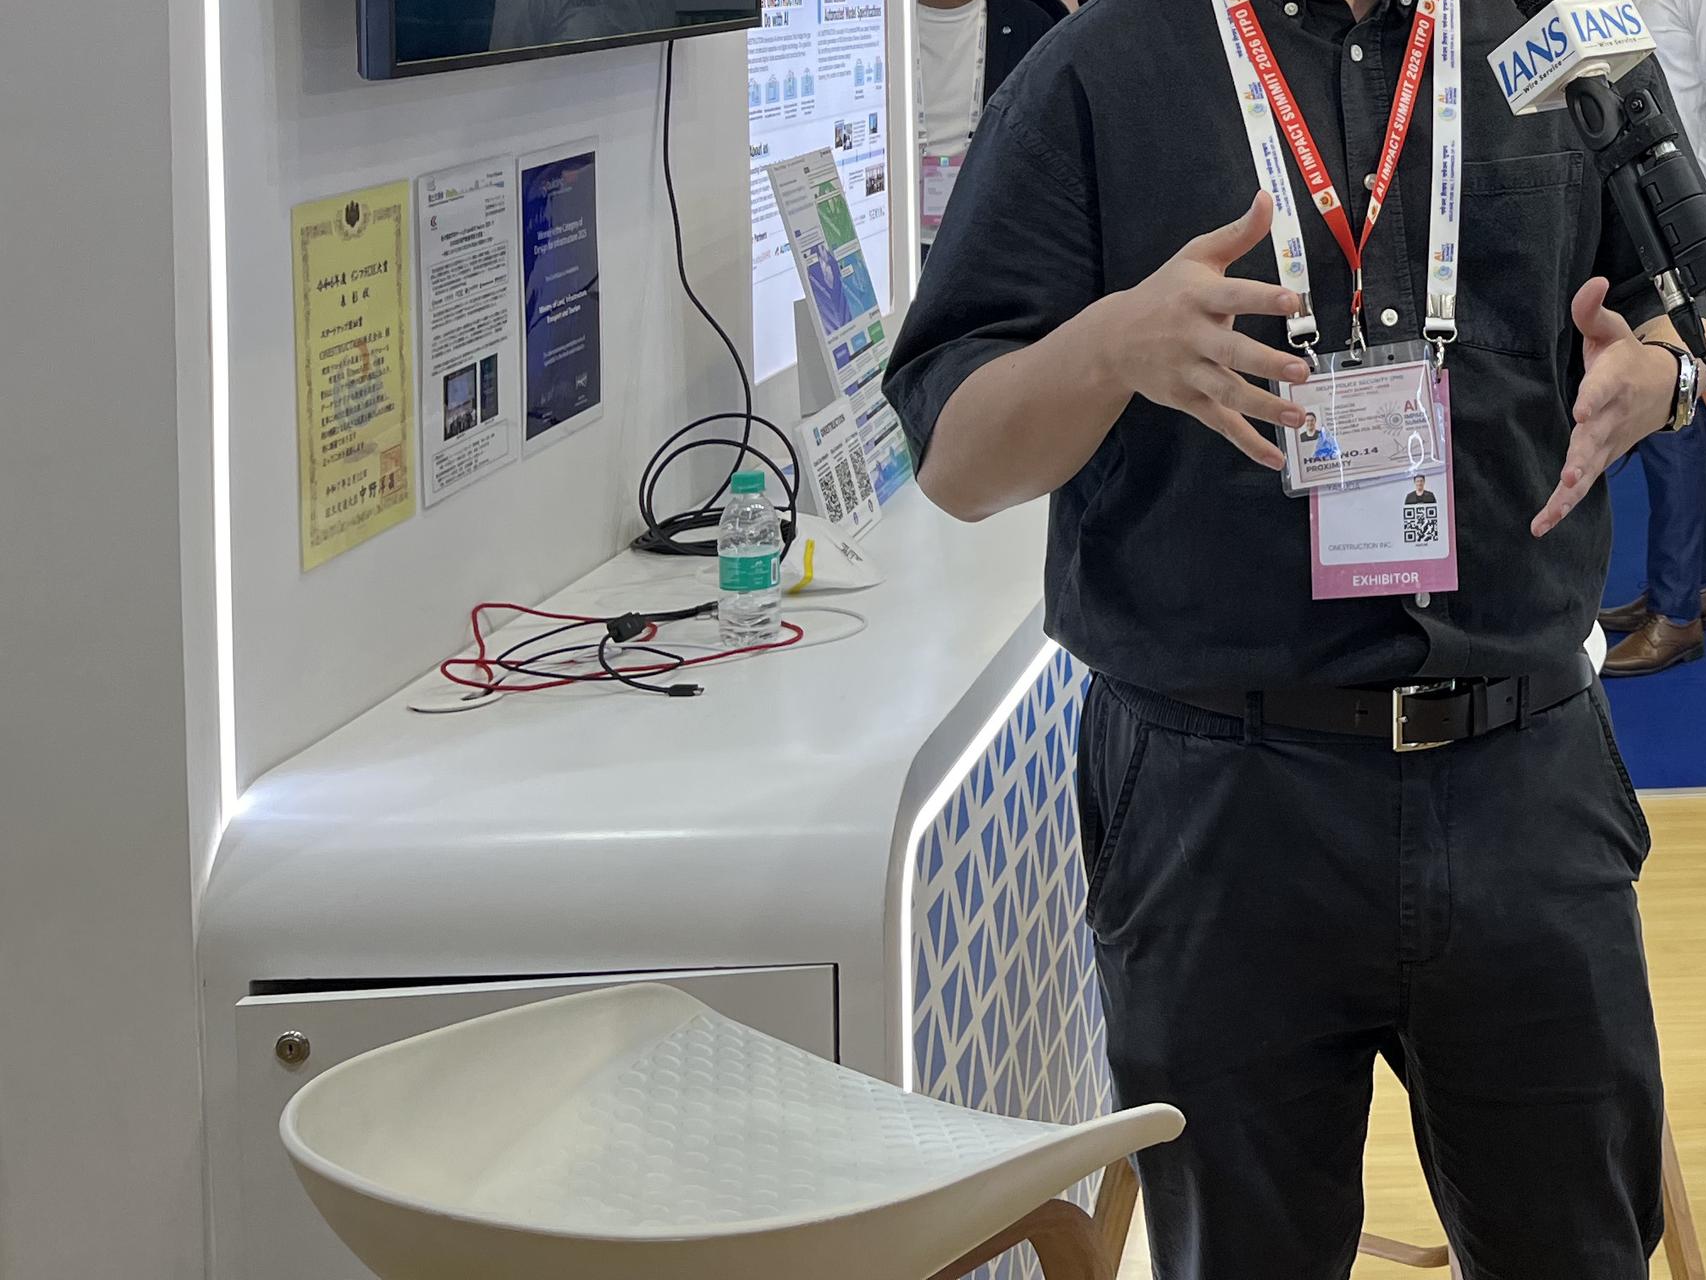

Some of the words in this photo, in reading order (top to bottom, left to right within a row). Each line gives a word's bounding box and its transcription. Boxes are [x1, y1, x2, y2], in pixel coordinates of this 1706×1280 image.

[1235, 8, 1257, 38] ITPO
[1414, 19, 1430, 48] ITPO
[1570, 3, 1642, 43] IANS
[1248, 38, 1272, 70] 2026
[1498, 16, 1568, 98] IANS
[1598, 40, 1614, 48] Wire
[1614, 37, 1637, 46] Service
[1406, 48, 1423, 80] 2026
[1522, 77, 1539, 94] Wire
[1539, 60, 1562, 82] Service
[1262, 71, 1296, 122] SUMMIT
[1393, 79, 1415, 132] SUMMIT
[1287, 123, 1318, 172] IMPACT
[1381, 131, 1401, 181] IMPACT
[1308, 173, 1324, 186] AI
[1375, 183, 1386, 198] AI
[1282, 249, 1290, 258] AI
[1434, 251, 1442, 261] AI
[1404, 399, 1418, 413] AI
[1306, 460, 1352, 473] PROXIMTY
[1340, 447, 1379, 459] NO.14
[1352, 571, 1420, 587] EXHIBITOR
